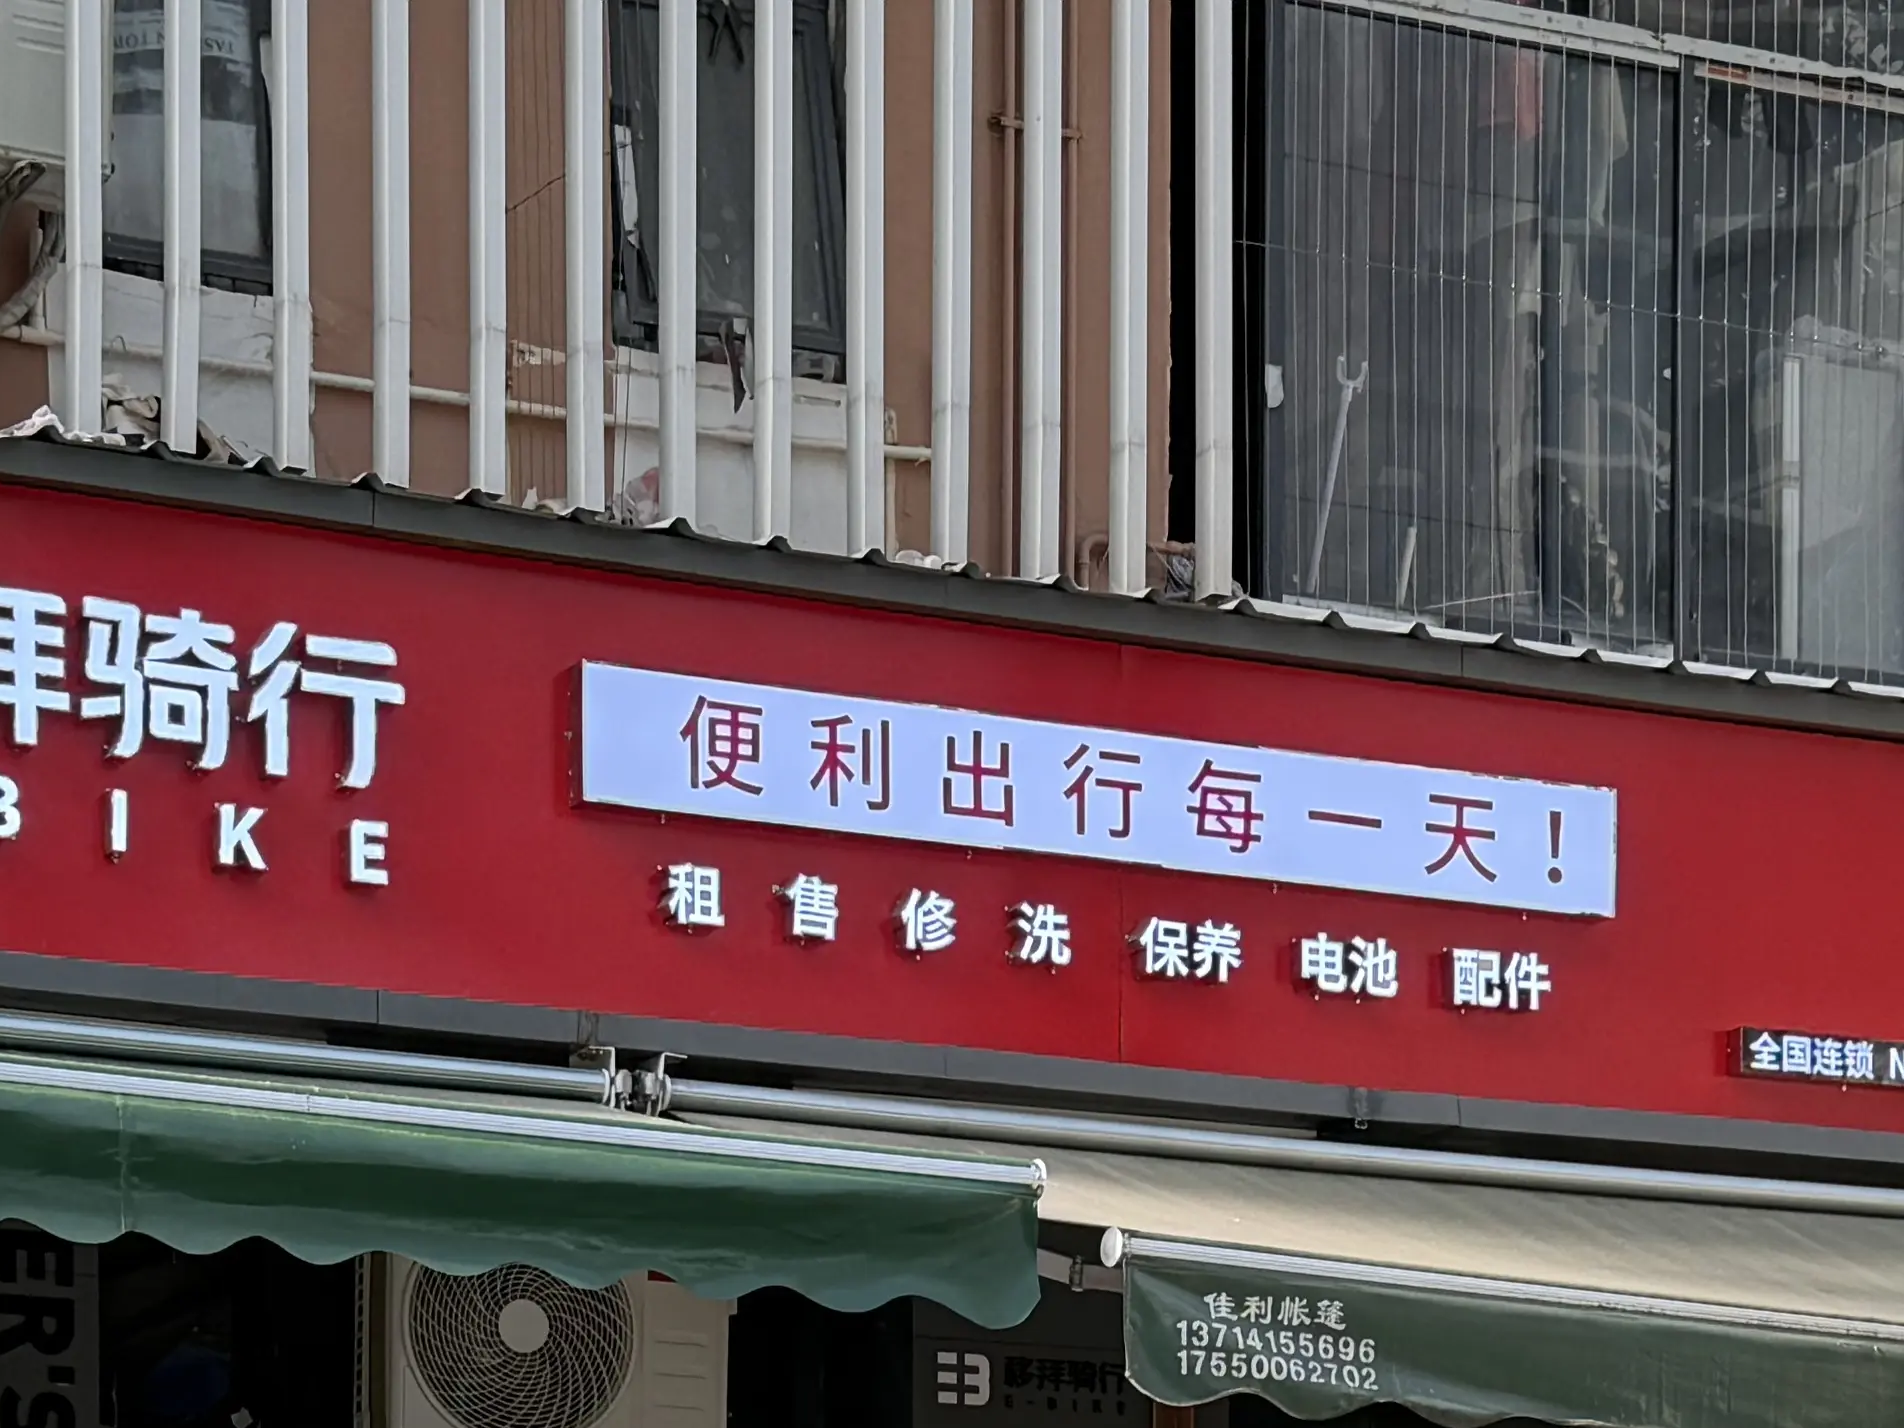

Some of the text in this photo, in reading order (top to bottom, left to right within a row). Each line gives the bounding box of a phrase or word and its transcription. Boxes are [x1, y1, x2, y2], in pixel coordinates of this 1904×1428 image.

[680, 694, 1565, 885] 便利出行每一天！
[665, 862, 1551, 1011] 租 售 修 洗 保养 电池 配件
[1750, 1032, 1875, 1081] 全国连锁
[1203, 1292, 1346, 1331] 佳利帐篷
[1176, 1320, 1376, 1363] 13714155696
[1004, 1357, 1125, 1395] 移拜骑行
[1177, 1350, 1379, 1392] 17550062702
